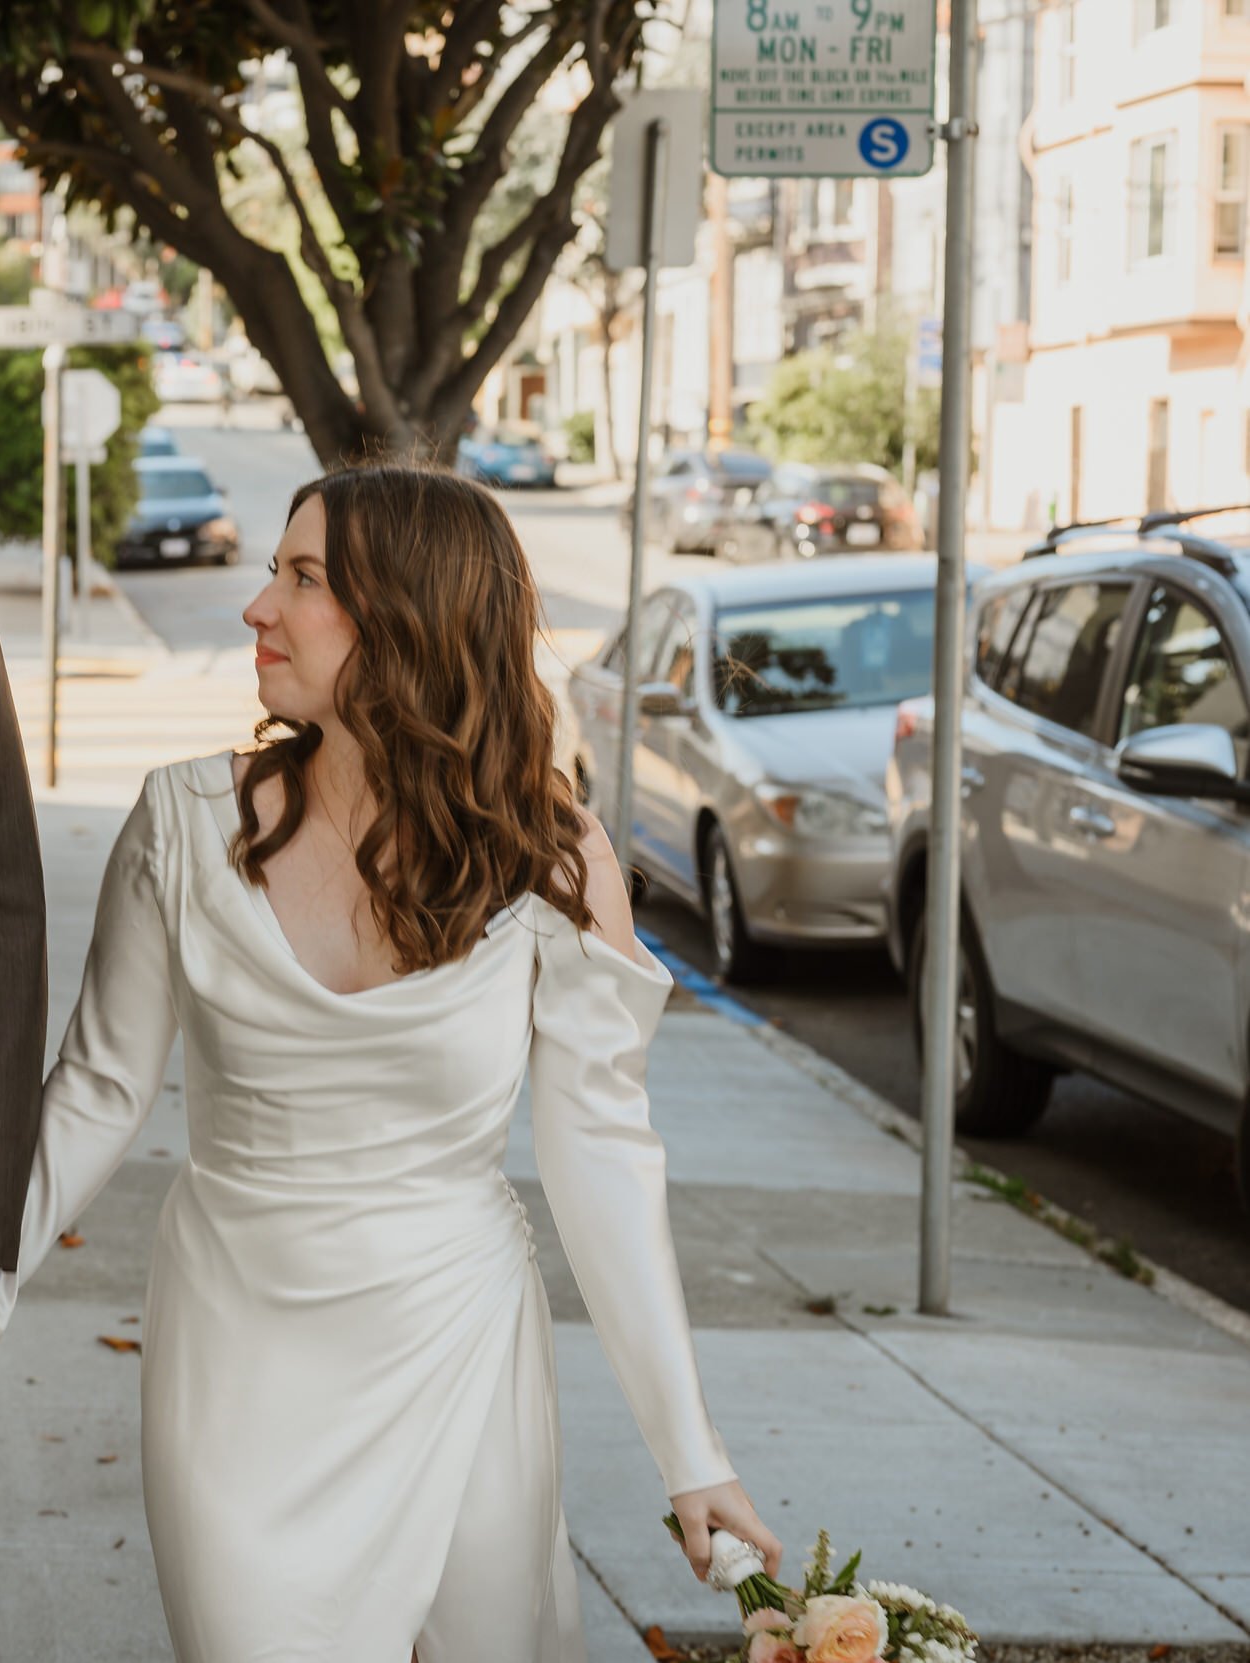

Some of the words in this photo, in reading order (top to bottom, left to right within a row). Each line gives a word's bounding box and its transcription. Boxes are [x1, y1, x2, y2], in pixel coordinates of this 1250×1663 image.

[816, 6, 833, 21] TO
[757, 36, 817, 64] MON
[850, 36, 893, 64] FRI
[720, 69, 751, 83] MOVE
[757, 69, 778, 83] OFF
[783, 69, 804, 83] THE
[812, 69, 849, 83] BLOCK
[855, 69, 870, 83] OR
[900, 69, 927, 83] MILE
[735, 88, 781, 104] BEFORE
[787, 88, 815, 103] TIME
[821, 88, 855, 103] LIMIT
[860, 88, 912, 104] EXPIRES
[735, 122, 796, 138] EXCEPT
[805, 122, 846, 138] AREA
[870, 125, 899, 162] S
[735, 145, 804, 161] PERMITS
